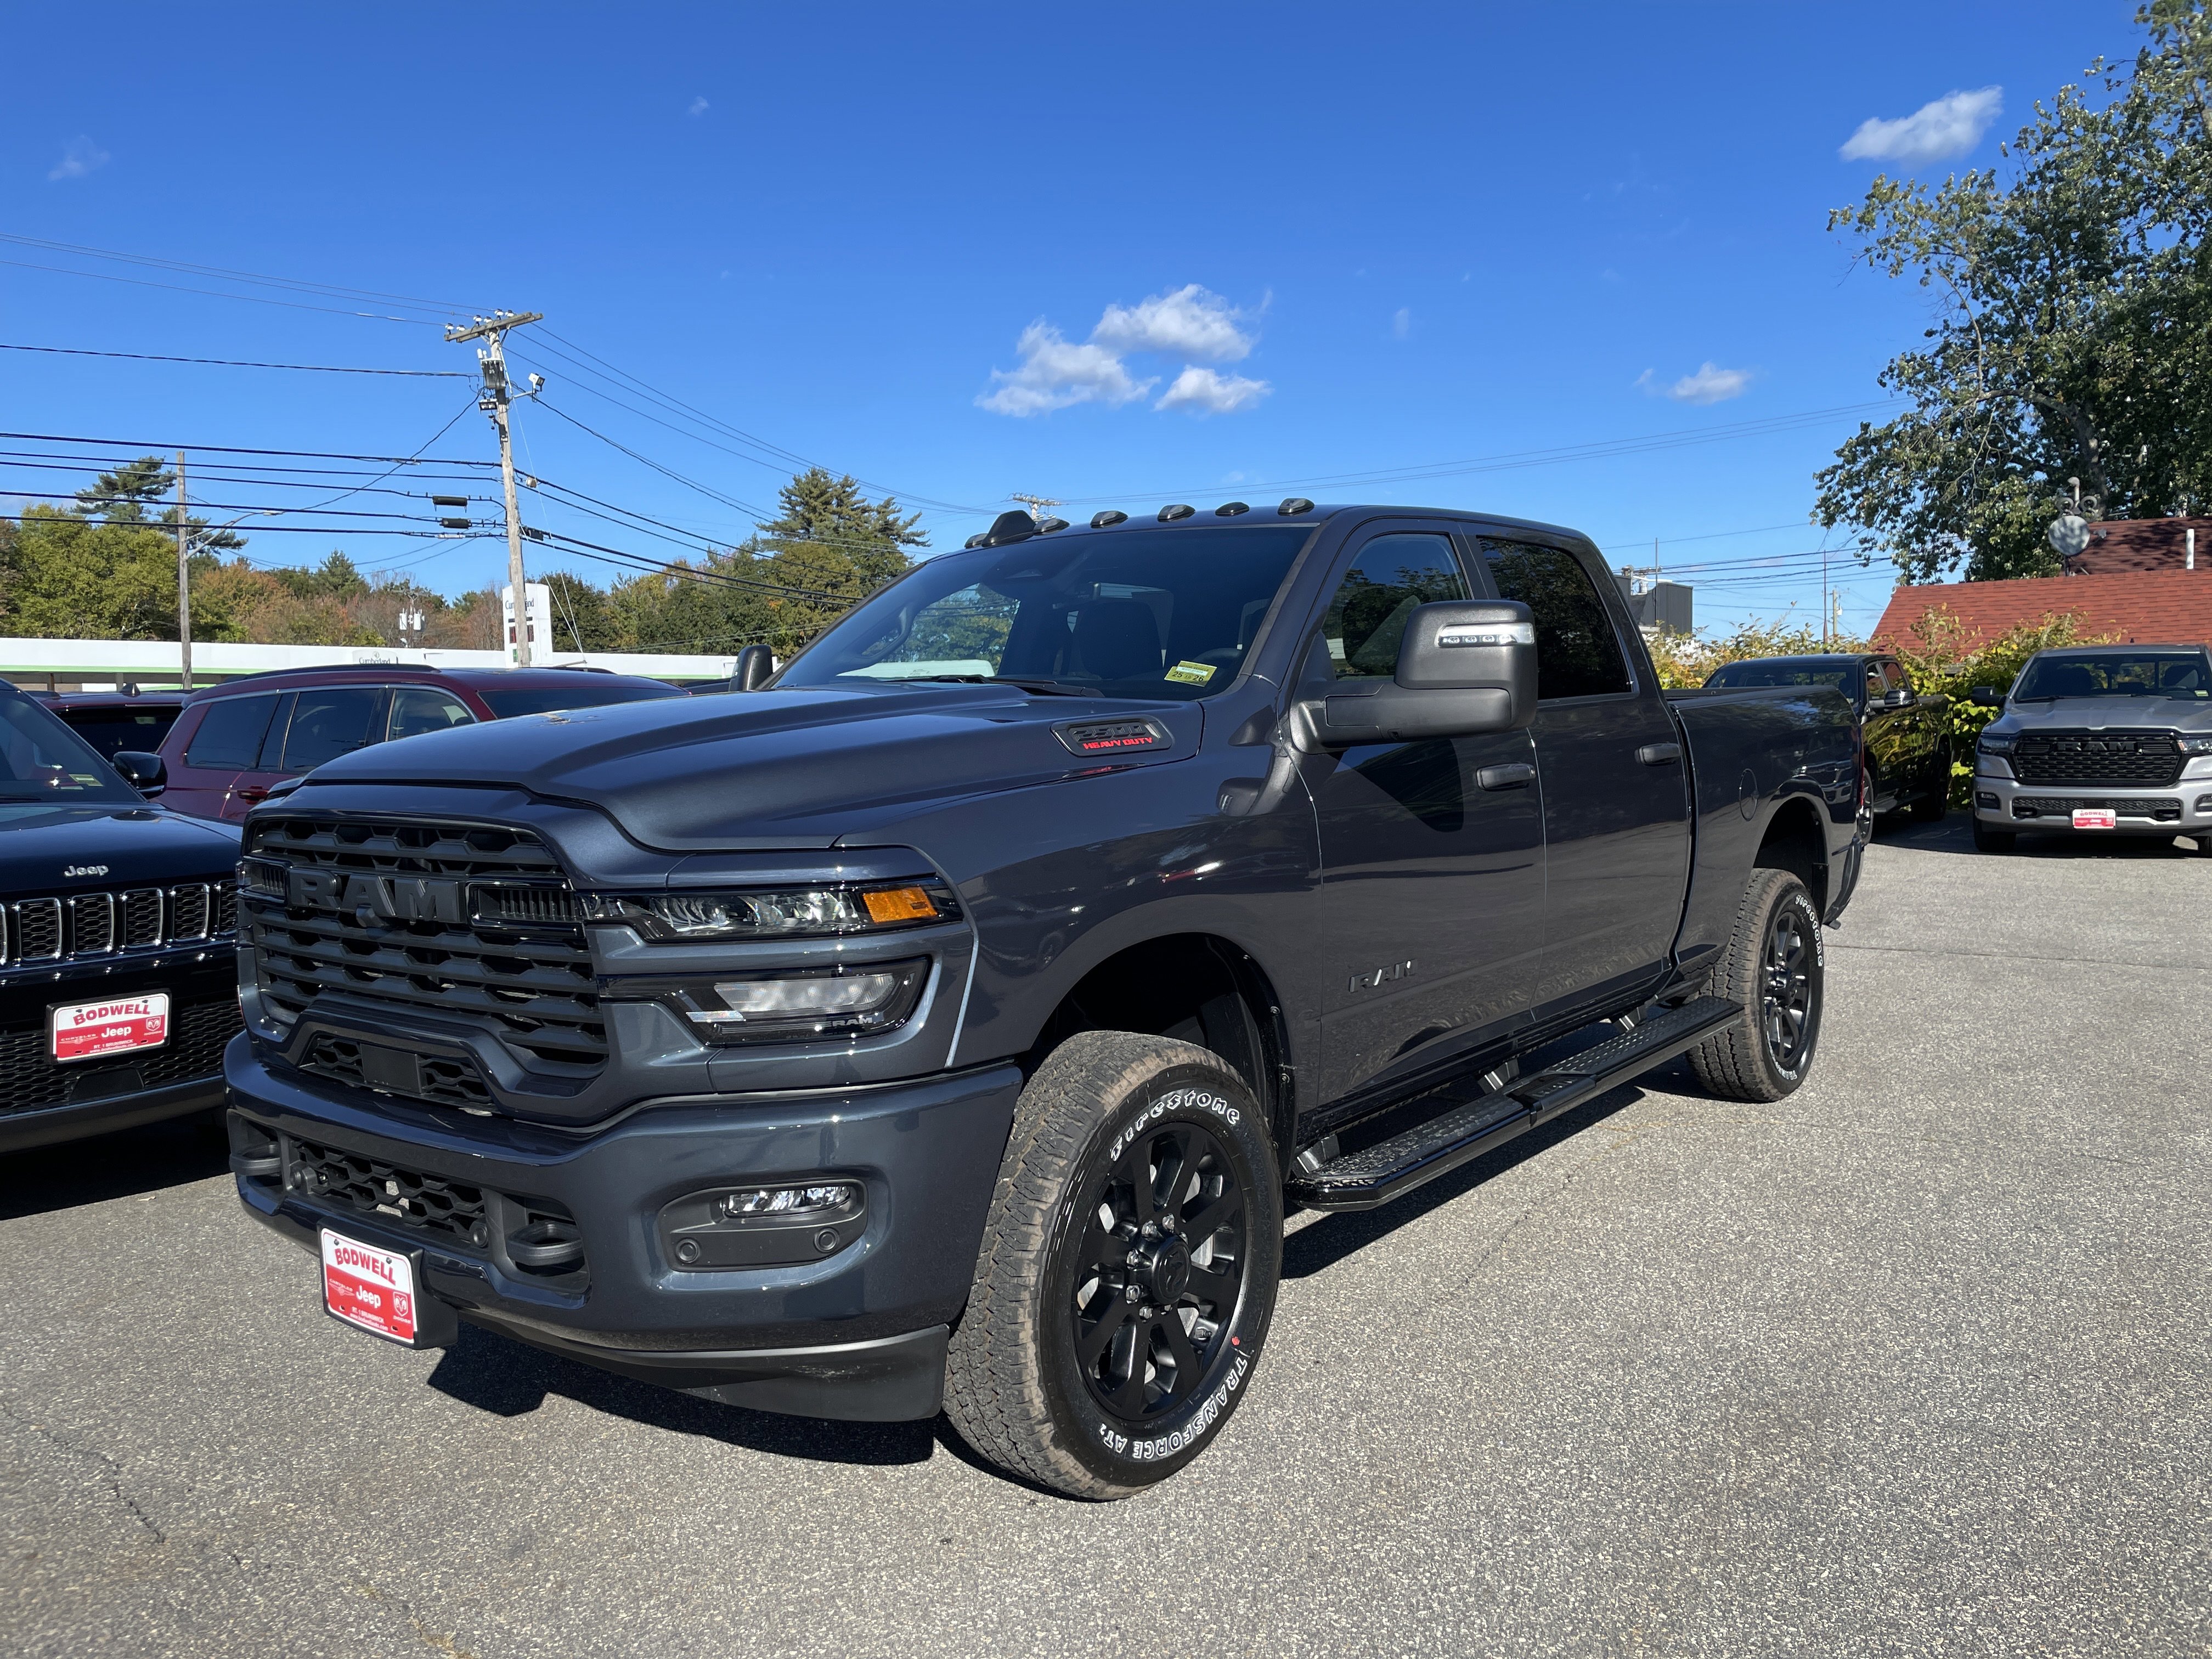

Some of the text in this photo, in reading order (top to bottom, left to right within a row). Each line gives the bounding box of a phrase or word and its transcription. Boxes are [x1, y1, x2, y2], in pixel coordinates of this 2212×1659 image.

[1074, 725, 1146, 742] 2500
[1083, 737, 1153, 750] HEAVY DUTY
[2058, 741, 2138, 752] RAM
[64, 865, 109, 877] Jeep
[288, 868, 466, 923] RAM
[1795, 894, 1824, 967] Firestone
[1348, 958, 1418, 994] RAM
[72, 1003, 150, 1026] BODWELL
[832, 1017, 873, 1026] RAM
[60, 1034, 97, 1042] CHRYSLER
[101, 1026, 132, 1039] Jeep
[1110, 1090, 1240, 1161] Firestone
[334, 1247, 396, 1286] BODWELL
[356, 1285, 381, 1309] Jeep
[1133, 1356, 1248, 1459] TRANSFORCE
